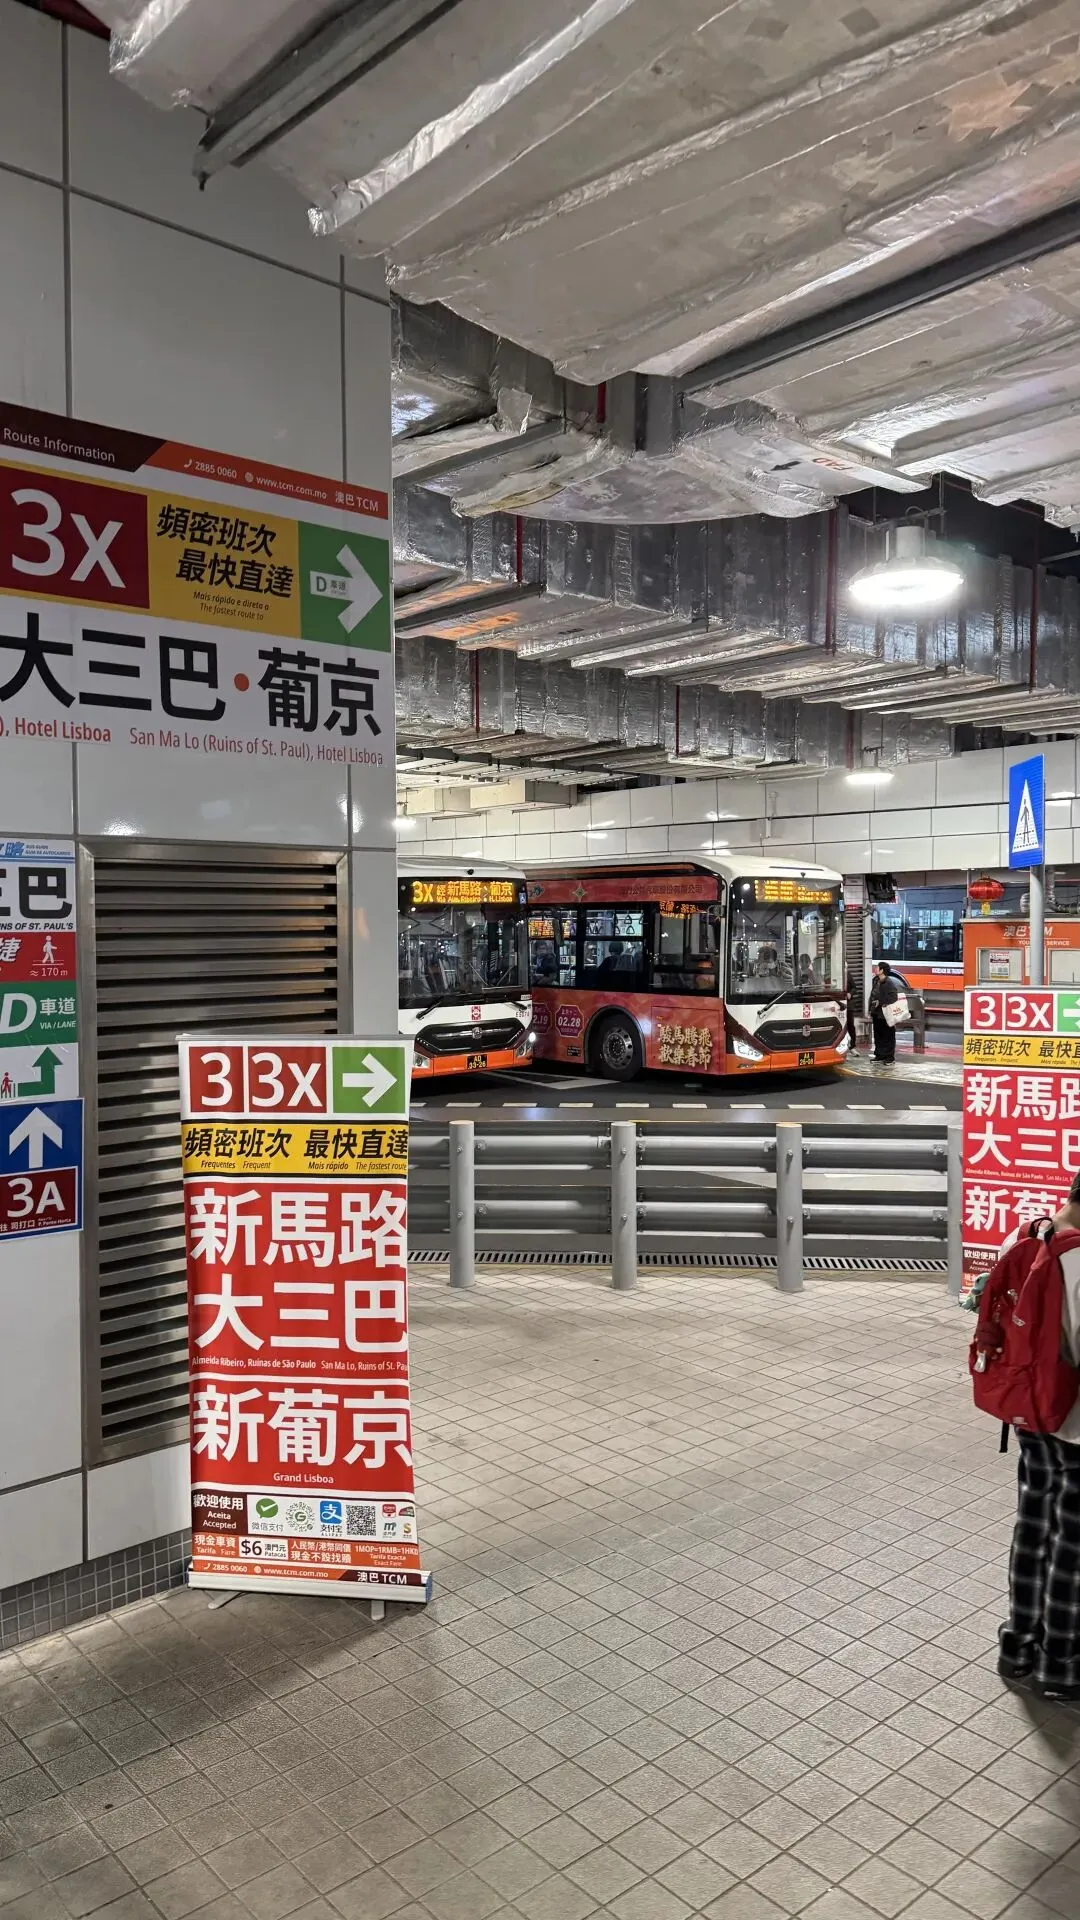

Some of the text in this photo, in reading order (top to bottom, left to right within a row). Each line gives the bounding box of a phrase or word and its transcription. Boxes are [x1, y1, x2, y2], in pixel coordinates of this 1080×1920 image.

[4, 427, 116, 463] Route Information
[194, 461, 237, 479] 2885 0060
[256, 475, 327, 500] www.tcm.com.mo
[335, 490, 379, 512] 澳巴 TCM
[156, 503, 277, 557] 頻密班次
[176, 547, 295, 599] 最快直達
[316, 576, 327, 592] D
[200, 602, 213, 612] The
[238, 610, 253, 620] route
[15, 717, 57, 739] Hotel
[62, 720, 112, 743] Lisboa
[130, 727, 384, 766] San Ma Lo (Ruins of St. Paul), Hotel Lisboa
[411, 880, 434, 903] 3X
[14, 922, 28, 930] OF
[28, 922, 42, 930] ST.
[43, 922, 74, 930] PAUL'S
[41, 967, 59, 977] 170
[0, 992, 37, 1034] D
[40, 997, 76, 1016] 車道
[975, 996, 997, 1027] 3
[40, 1022, 51, 1030] VIA
[57, 1020, 76, 1029] LANE
[557, 1016, 581, 1028] 02.28
[966, 1037, 1031, 1057] 頻密班次
[200, 1052, 233, 1107] 3
[184, 1127, 408, 1160] 頻密班次 最快直達
[201, 1160, 407, 1172] Frequentes Frequent Mais rápido The fastest route
[7, 1177, 65, 1218] 3A
[190, 1187, 408, 1268] 新馬路
[194, 1273, 409, 1353] 大三巴
[192, 1355, 219, 1365] Almeida
[220, 1357, 246, 1368] Ribeiro,
[272, 1359, 281, 1367] de
[281, 1359, 294, 1368] São
[296, 1360, 317, 1369] Paulo
[321, 1360, 333, 1370] San
[335, 1361, 346, 1370] Ma
[346, 1361, 357, 1371] Lo,
[358, 1361, 376, 1371] Ruins
[378, 1360, 386, 1370] of
[193, 1384, 413, 1469] 新葡京
[273, 1472, 334, 1484] Grand Lisboa
[193, 1494, 244, 1511] 歡迎使用
[207, 1511, 231, 1520] Aceita
[203, 1519, 237, 1530] Accepted
[251, 1521, 284, 1532] 微信支付
[195, 1533, 236, 1547] 現金車資
[241, 1539, 262, 1556] $6
[264, 1543, 286, 1553] 澳門元
[197, 1546, 236, 1556] Tarifa Fare
[264, 1551, 287, 1559] Patacas
[212, 1563, 248, 1574] 2885 0060
[263, 1567, 328, 1579] www.tcm.com.mo
[357, 1571, 408, 1585] 澳巴 TCM
